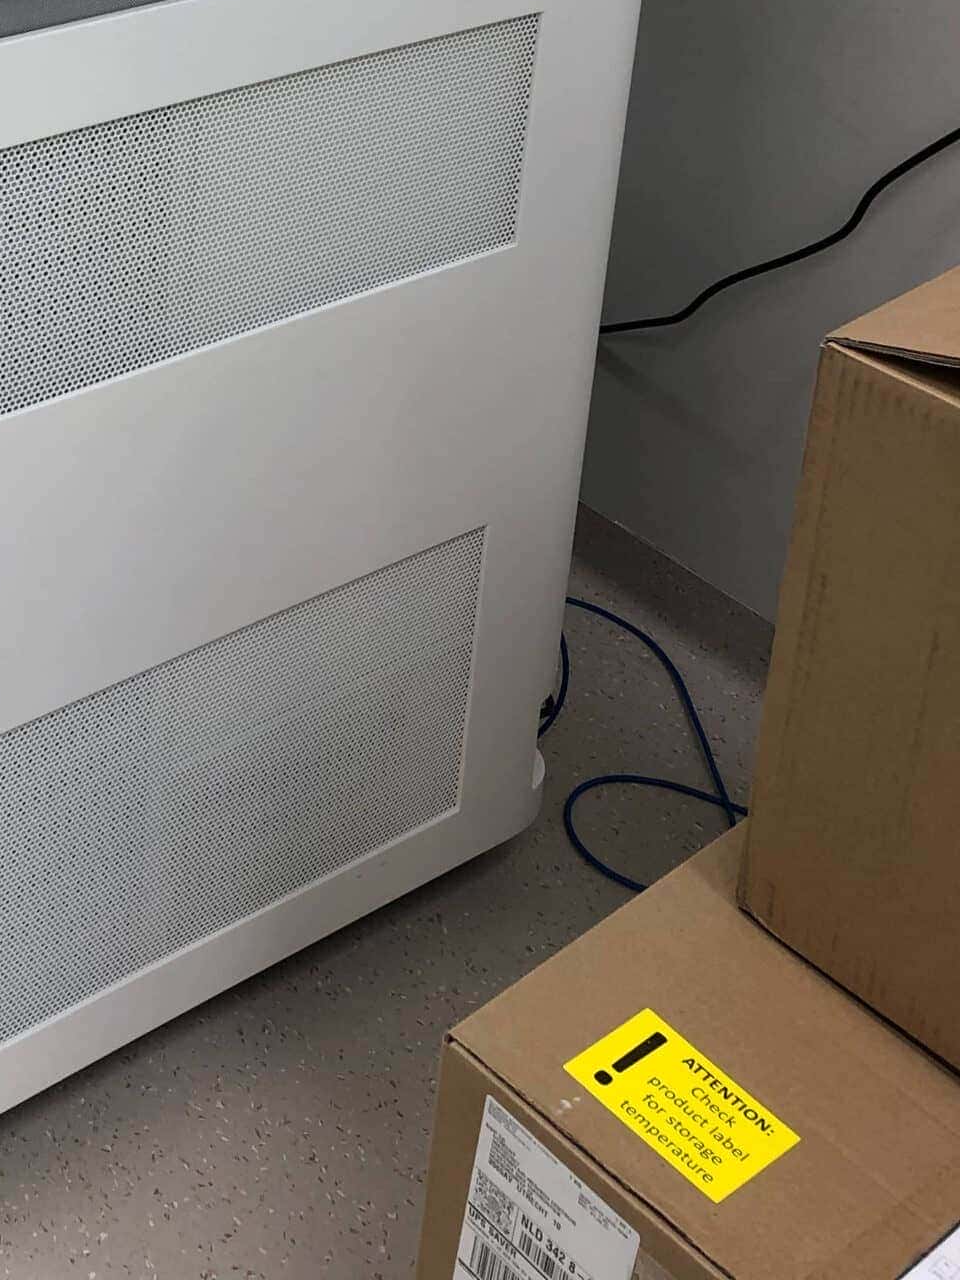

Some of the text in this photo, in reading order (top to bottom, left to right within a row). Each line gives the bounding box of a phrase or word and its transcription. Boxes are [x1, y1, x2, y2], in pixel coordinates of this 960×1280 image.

[642, 1093, 722, 1166] for storage
[647, 1076, 750, 1162] product label
[682, 1058, 775, 1136] ATTENTION:
[691, 1087, 736, 1128] Check
[620, 1099, 714, 1183] temperature
[521, 1213, 543, 1242] NLD
[545, 1239, 566, 1265] 342
